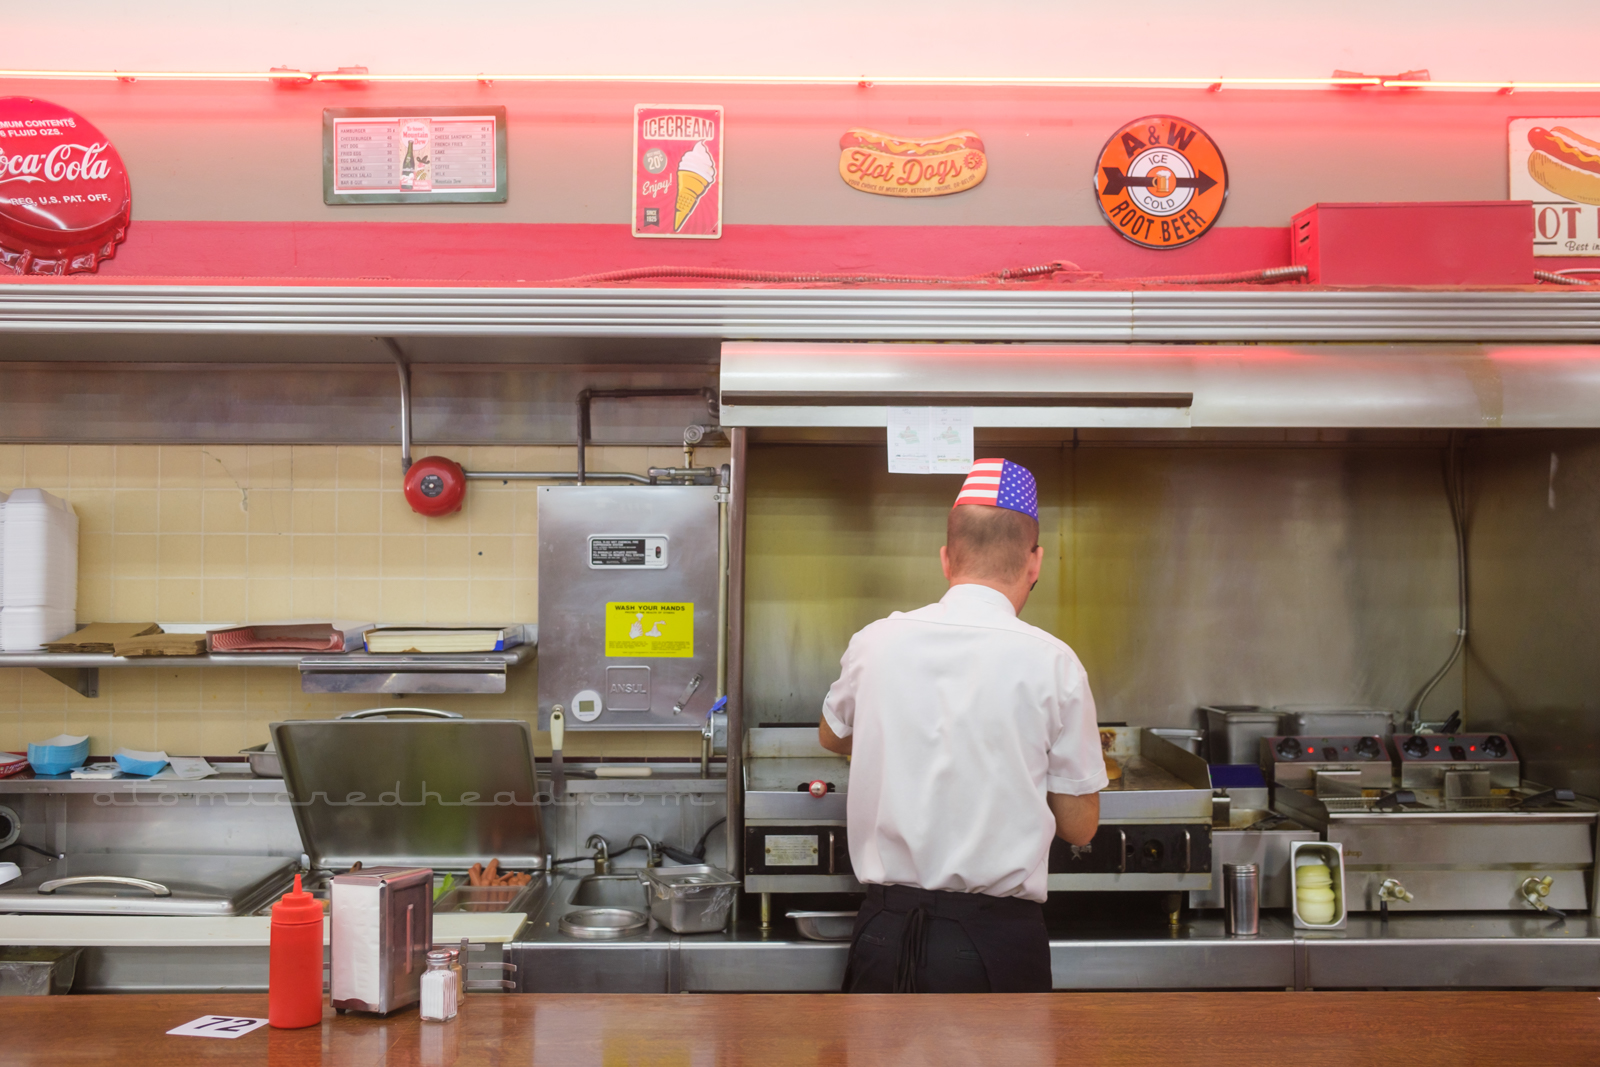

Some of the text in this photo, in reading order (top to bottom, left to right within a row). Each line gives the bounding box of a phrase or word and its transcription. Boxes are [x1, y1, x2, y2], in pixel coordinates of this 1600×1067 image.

[25, 118, 75, 128] CONTENTS
[644, 116, 713, 138] ICECREAM
[8, 129, 37, 137] FLUID
[0, 142, 111, 184] oca-Cola
[1148, 154, 1168, 165] ICE
[847, 150, 963, 185] Hot Dogs
[642, 173, 672, 198] Enjoy!
[861, 182, 877, 191] CHOICE
[39, 196, 61, 205] U.S.
[63, 195, 85, 203] PAT.
[87, 194, 111, 202] OFF.
[1143, 196, 1175, 210] COLD
[1109, 200, 1206, 242] ROOT BEER
[1532, 206, 1582, 240] OT
[1565, 241, 1589, 251] Best
[610, 683, 647, 694] ANSUL
[194, 1017, 257, 1032] 72
